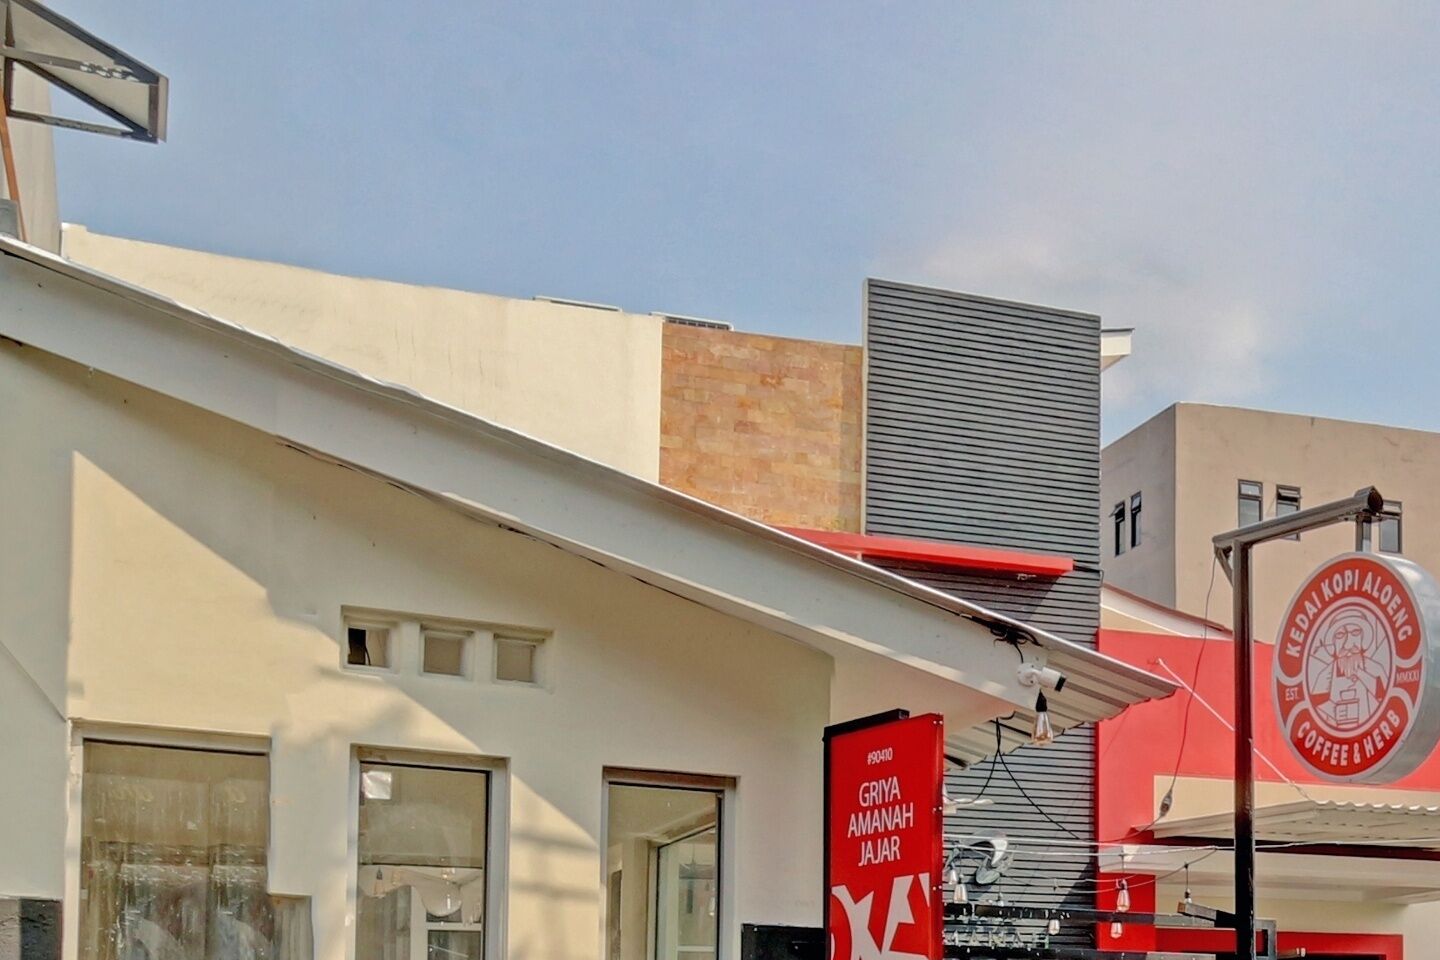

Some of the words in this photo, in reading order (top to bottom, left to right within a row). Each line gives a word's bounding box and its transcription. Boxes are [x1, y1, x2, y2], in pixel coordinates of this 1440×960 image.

[1286, 591, 1323, 658] KEDAI
[1321, 569, 1360, 602] KOPI
[1362, 571, 1412, 642] ALOENG
[1297, 720, 1350, 766] COFFEE
[1353, 743, 1361, 764] &
[1364, 709, 1400, 758] HERB
[867, 747, 893, 765] #90410
[859, 776, 901, 807] GRIYA
[847, 802, 914, 838] AMANAH
[858, 836, 901, 867] JAJAR
